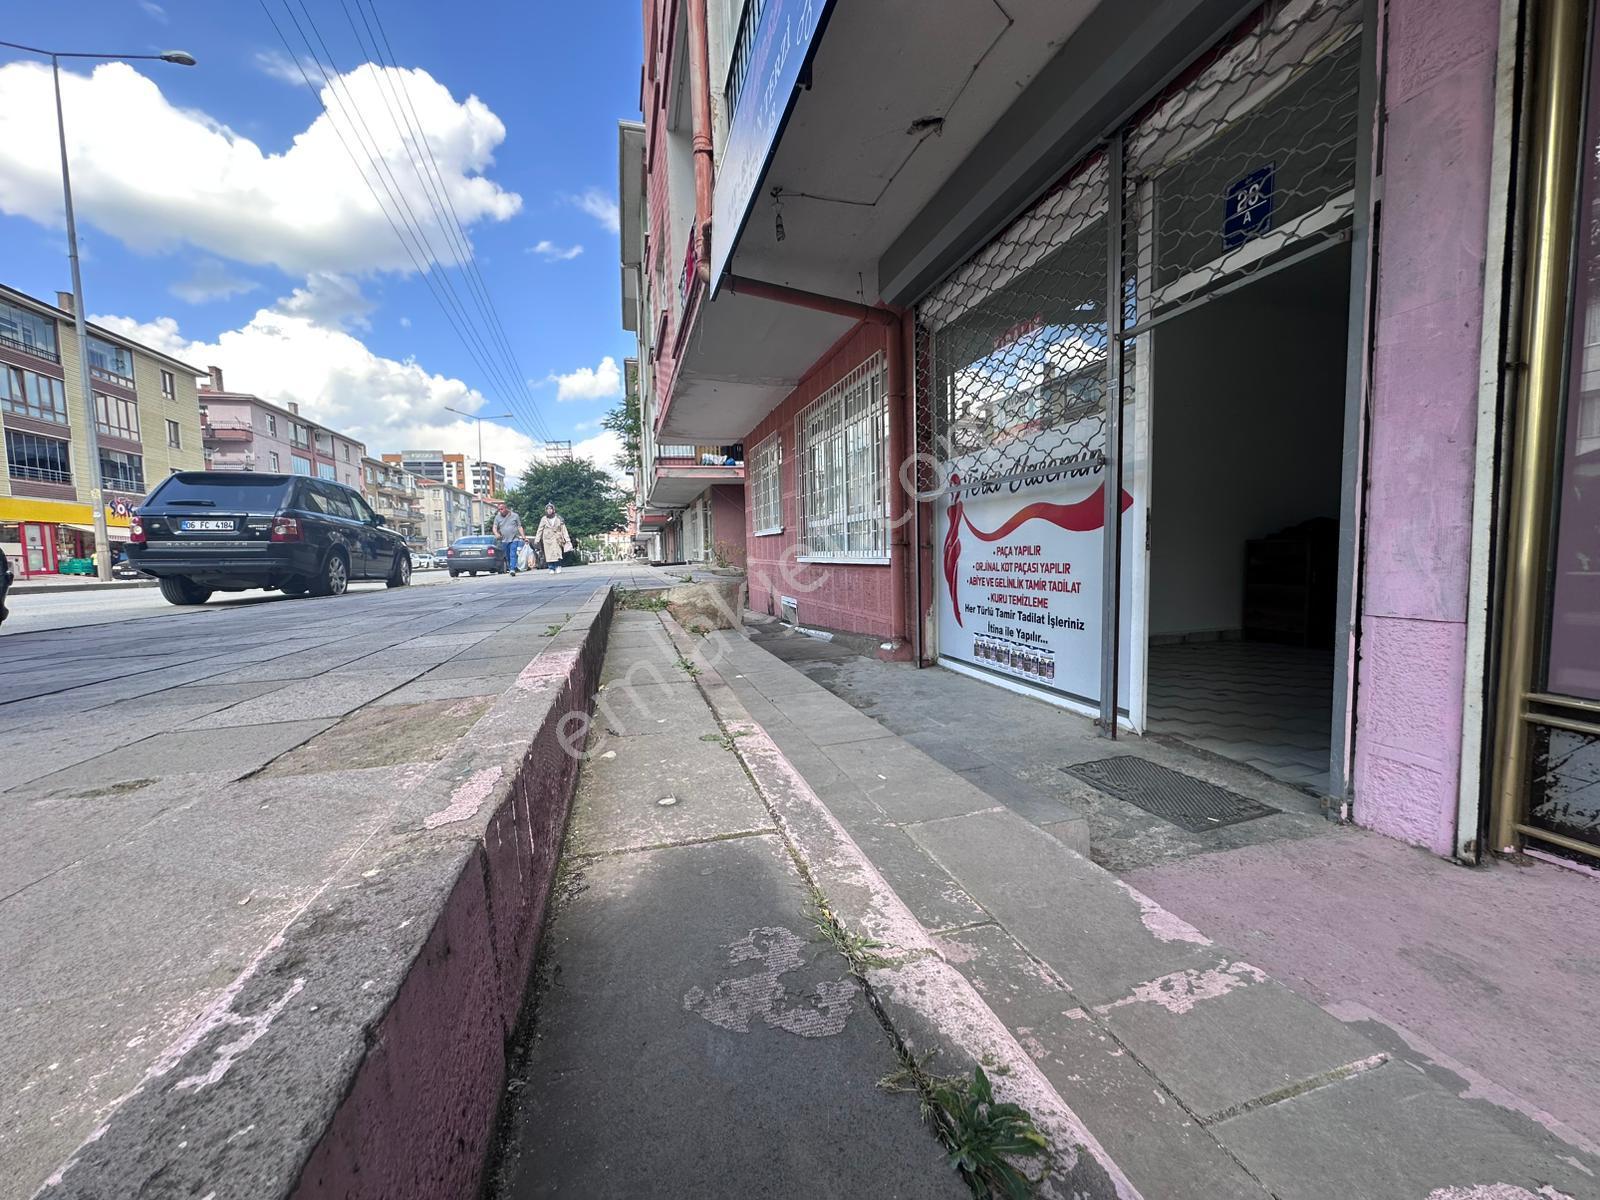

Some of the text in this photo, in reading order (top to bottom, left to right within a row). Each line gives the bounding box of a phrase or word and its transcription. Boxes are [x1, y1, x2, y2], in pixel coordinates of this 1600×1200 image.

[1242, 211, 1252, 225] A
[186, 520, 233, 529] 06 FC 4184
[996, 545, 1041, 558] PAÇA YAPILIR
[1001, 562, 1013, 572] KOT
[1014, 562, 1039, 575] PAÇASI
[1040, 562, 1071, 574] YAPILIR
[969, 575, 1082, 593] ABİYE VE GELİNLİK TAMİR TADİLAT
[990, 593, 1048, 608] KURU TEMİZLEME
[964, 603, 1085, 631] Her Türlü Tamir Tadilat İşleriniz
[987, 621, 1048, 644] İtina ile Yapılır...
